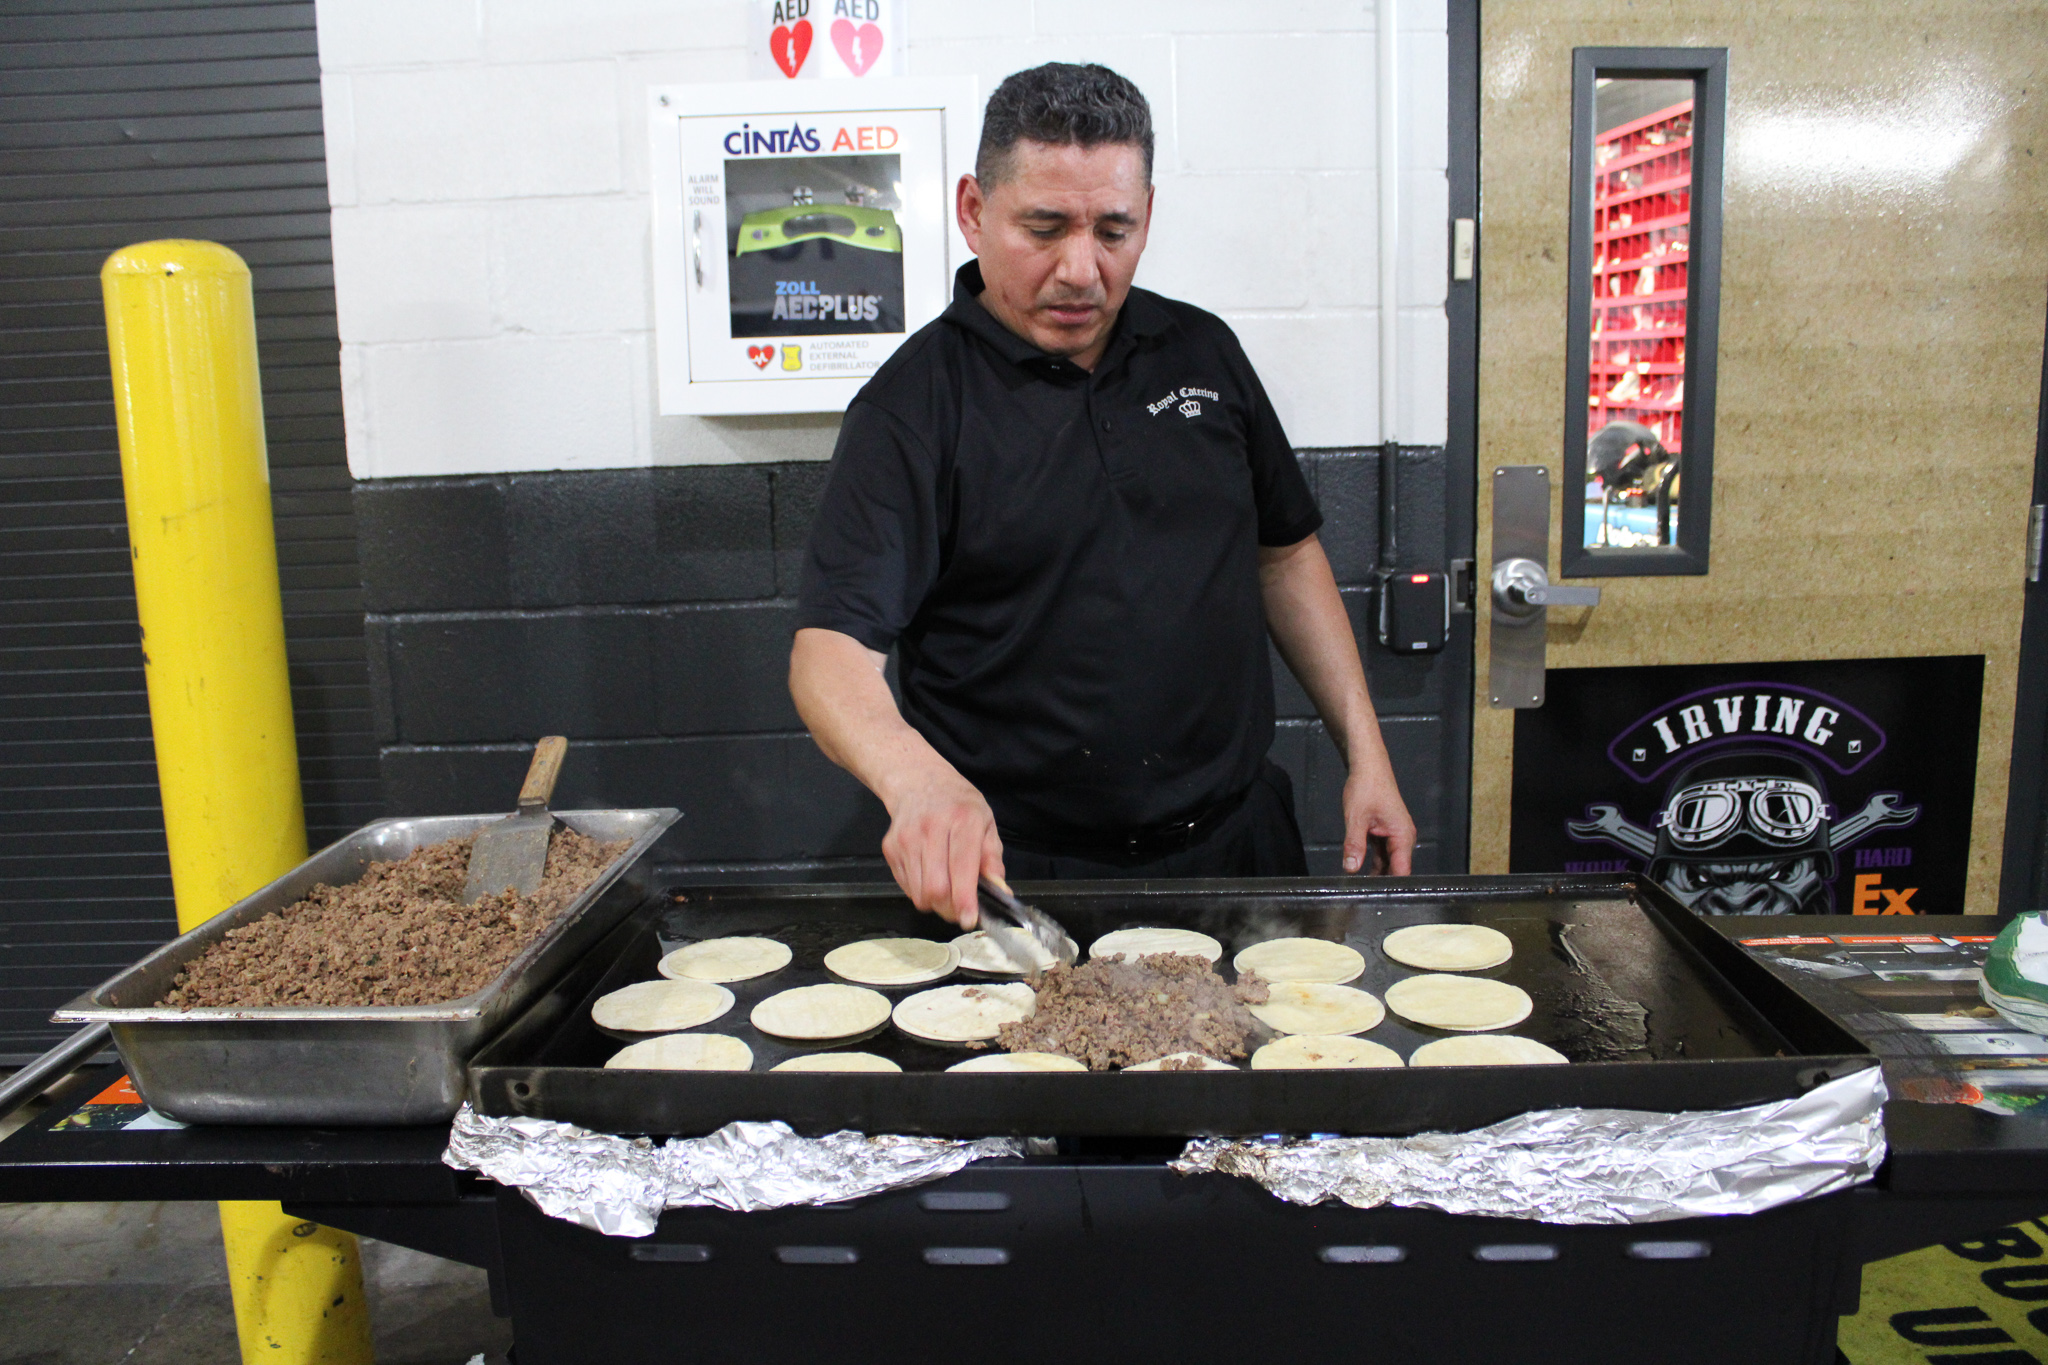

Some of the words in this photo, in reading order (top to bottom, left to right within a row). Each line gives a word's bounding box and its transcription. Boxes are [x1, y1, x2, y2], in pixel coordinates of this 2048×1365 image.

[773, 0, 809, 25] AED
[833, 0, 879, 21] AED
[831, 126, 899, 151] AED
[688, 174, 719, 184] ALARM
[693, 186, 714, 195] WILL
[688, 195, 720, 206] SOUND
[775, 281, 820, 295] ZOLL
[809, 340, 869, 350] AUTOMATED
[809, 352, 858, 361] EXTERNAL
[809, 361, 880, 372] DEFIBRILLATOR
[1146, 391, 1179, 417] Royal
[1179, 387, 1219, 402] Catering
[1652, 694, 1840, 754] IRVING
